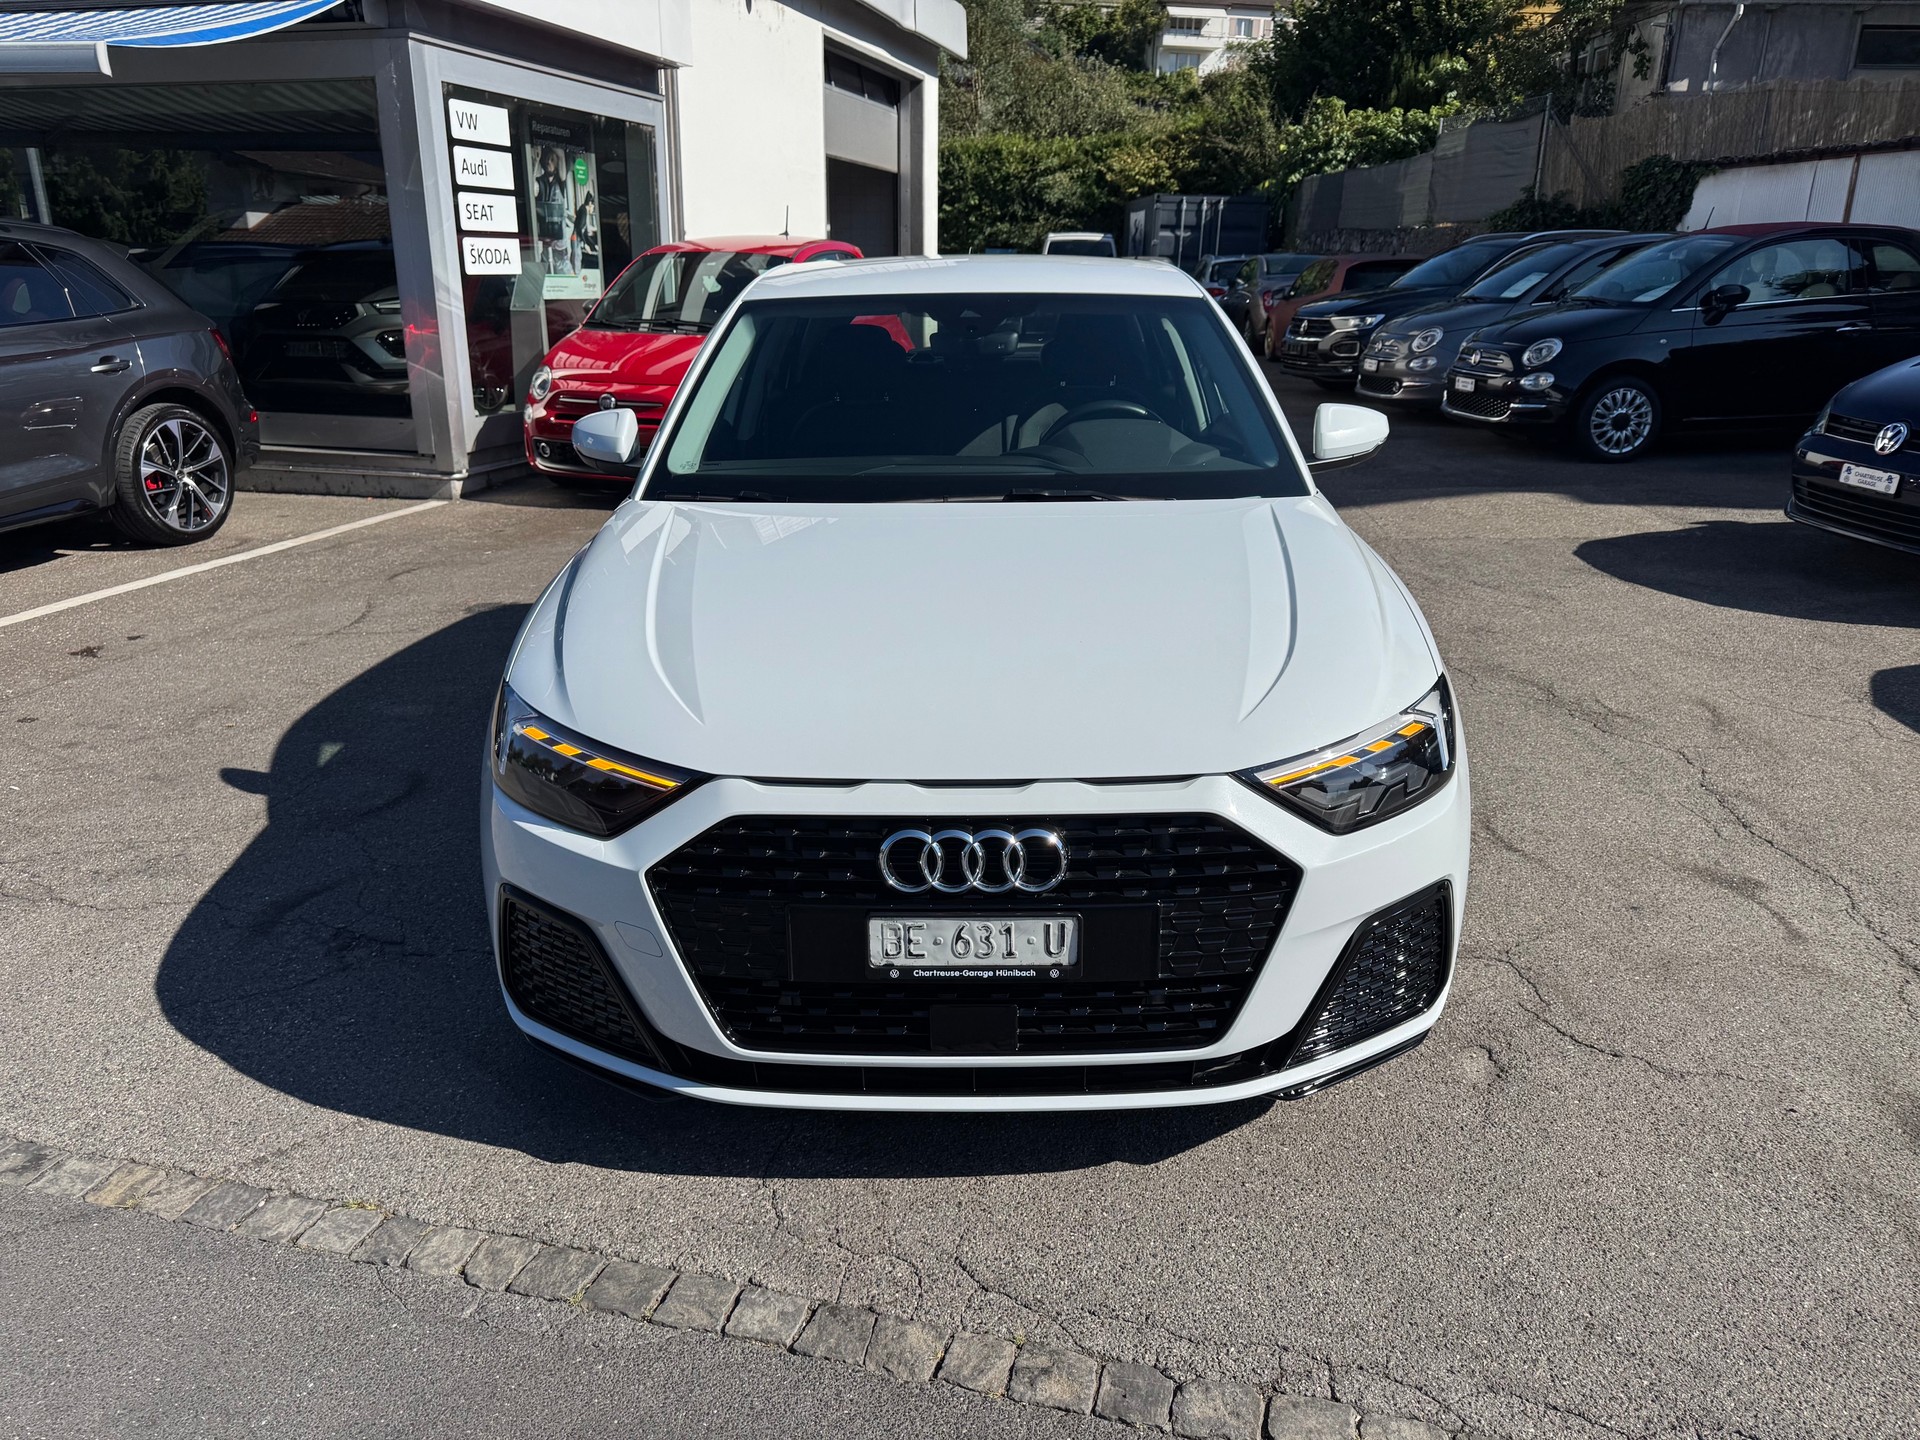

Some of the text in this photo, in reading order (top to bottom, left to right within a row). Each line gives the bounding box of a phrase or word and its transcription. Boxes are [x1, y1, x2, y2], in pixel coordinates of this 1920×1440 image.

[455, 110, 478, 131] VW
[532, 120, 571, 137] Reparaturen
[461, 158, 488, 177] Audi
[465, 203, 494, 222] SEAT
[470, 244, 511, 265] ŠKODA
[1855, 471, 1884, 482] CHARTREUSE
[1857, 479, 1877, 487] GARAGE
[913, 969, 994, 979] Chartreuse-Garage
[995, 968, 1036, 977] Hünibach
